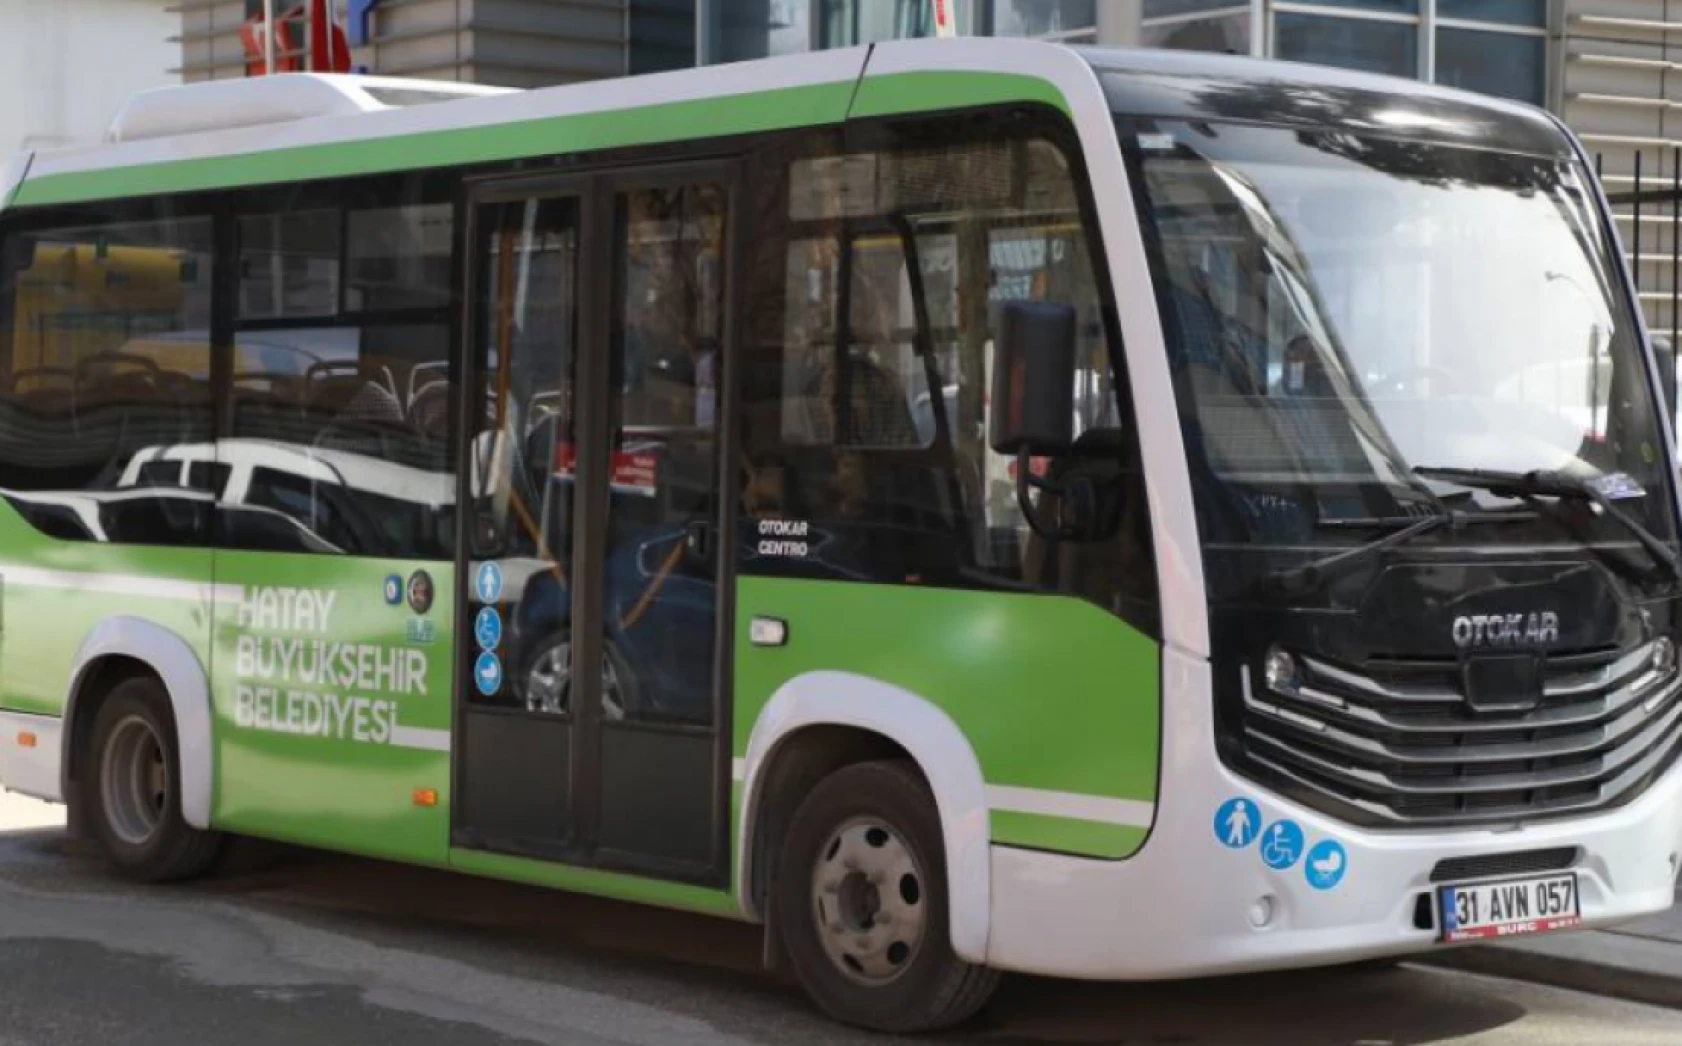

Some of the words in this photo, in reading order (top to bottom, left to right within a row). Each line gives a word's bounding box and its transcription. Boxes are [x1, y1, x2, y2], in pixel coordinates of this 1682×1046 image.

[758, 520, 808, 536] OTOKAR
[758, 540, 808, 556] CENTRO
[238, 584, 336, 633] HATAY
[1452, 611, 1559, 647] OTOKAR
[1456, 891, 1479, 924] 31
[1491, 885, 1529, 921] AVN
[1537, 880, 1572, 915] 057
